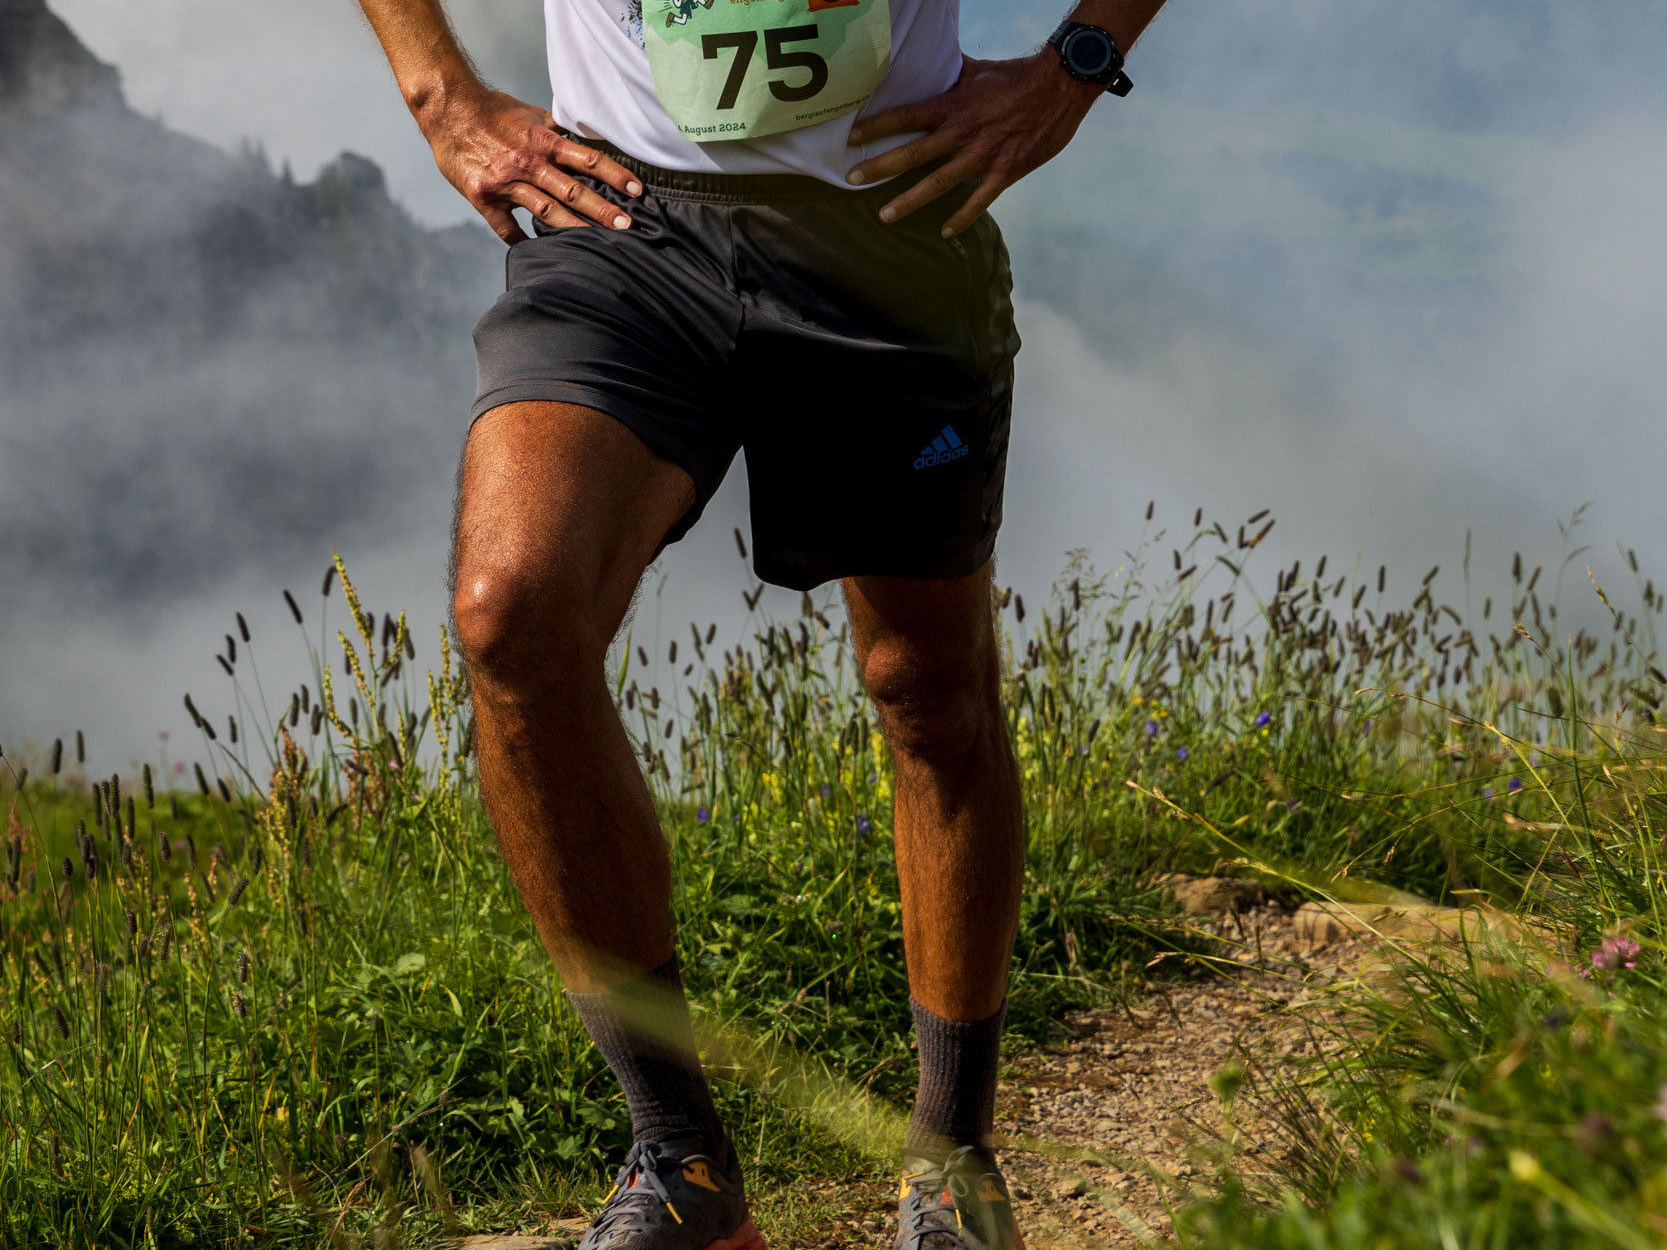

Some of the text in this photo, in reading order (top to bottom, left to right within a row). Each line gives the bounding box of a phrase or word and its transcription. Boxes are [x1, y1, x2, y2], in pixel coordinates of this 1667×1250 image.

[701, 24, 828, 110] 75
[684, 125, 717, 136] August
[719, 122, 746, 132] 2024
[913, 444, 969, 470] adidas
